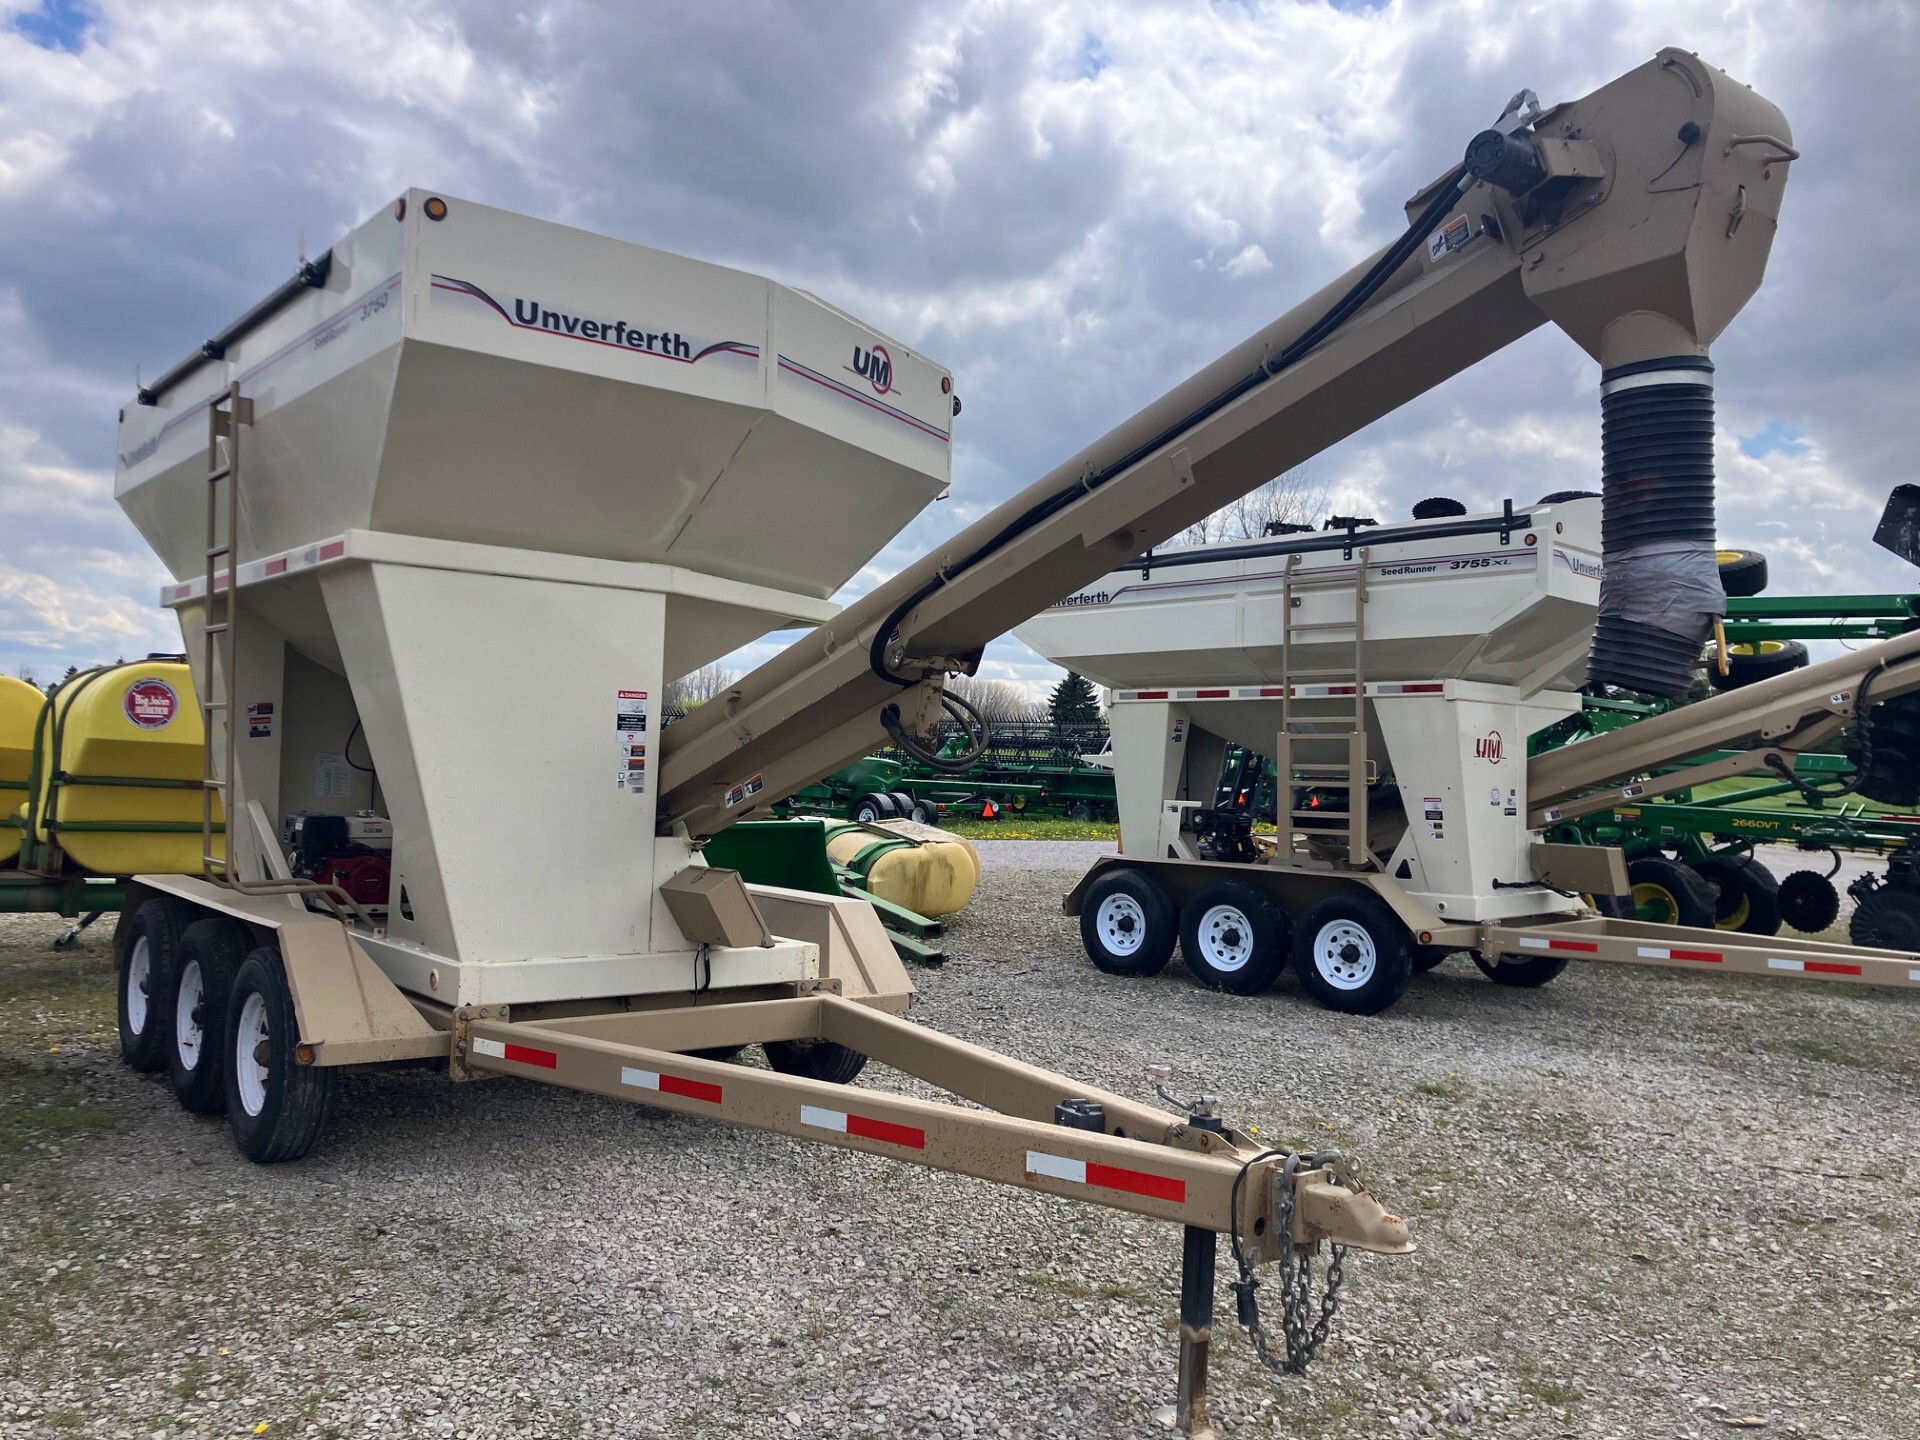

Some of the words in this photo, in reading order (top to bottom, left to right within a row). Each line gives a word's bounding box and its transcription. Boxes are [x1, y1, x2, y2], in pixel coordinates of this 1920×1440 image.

[515, 298, 691, 359] Unverferth
[853, 345, 890, 387] UM
[1053, 590, 1109, 607] verferth
[1476, 738, 1501, 759] UM
[1732, 818, 1781, 830] 2660VT
